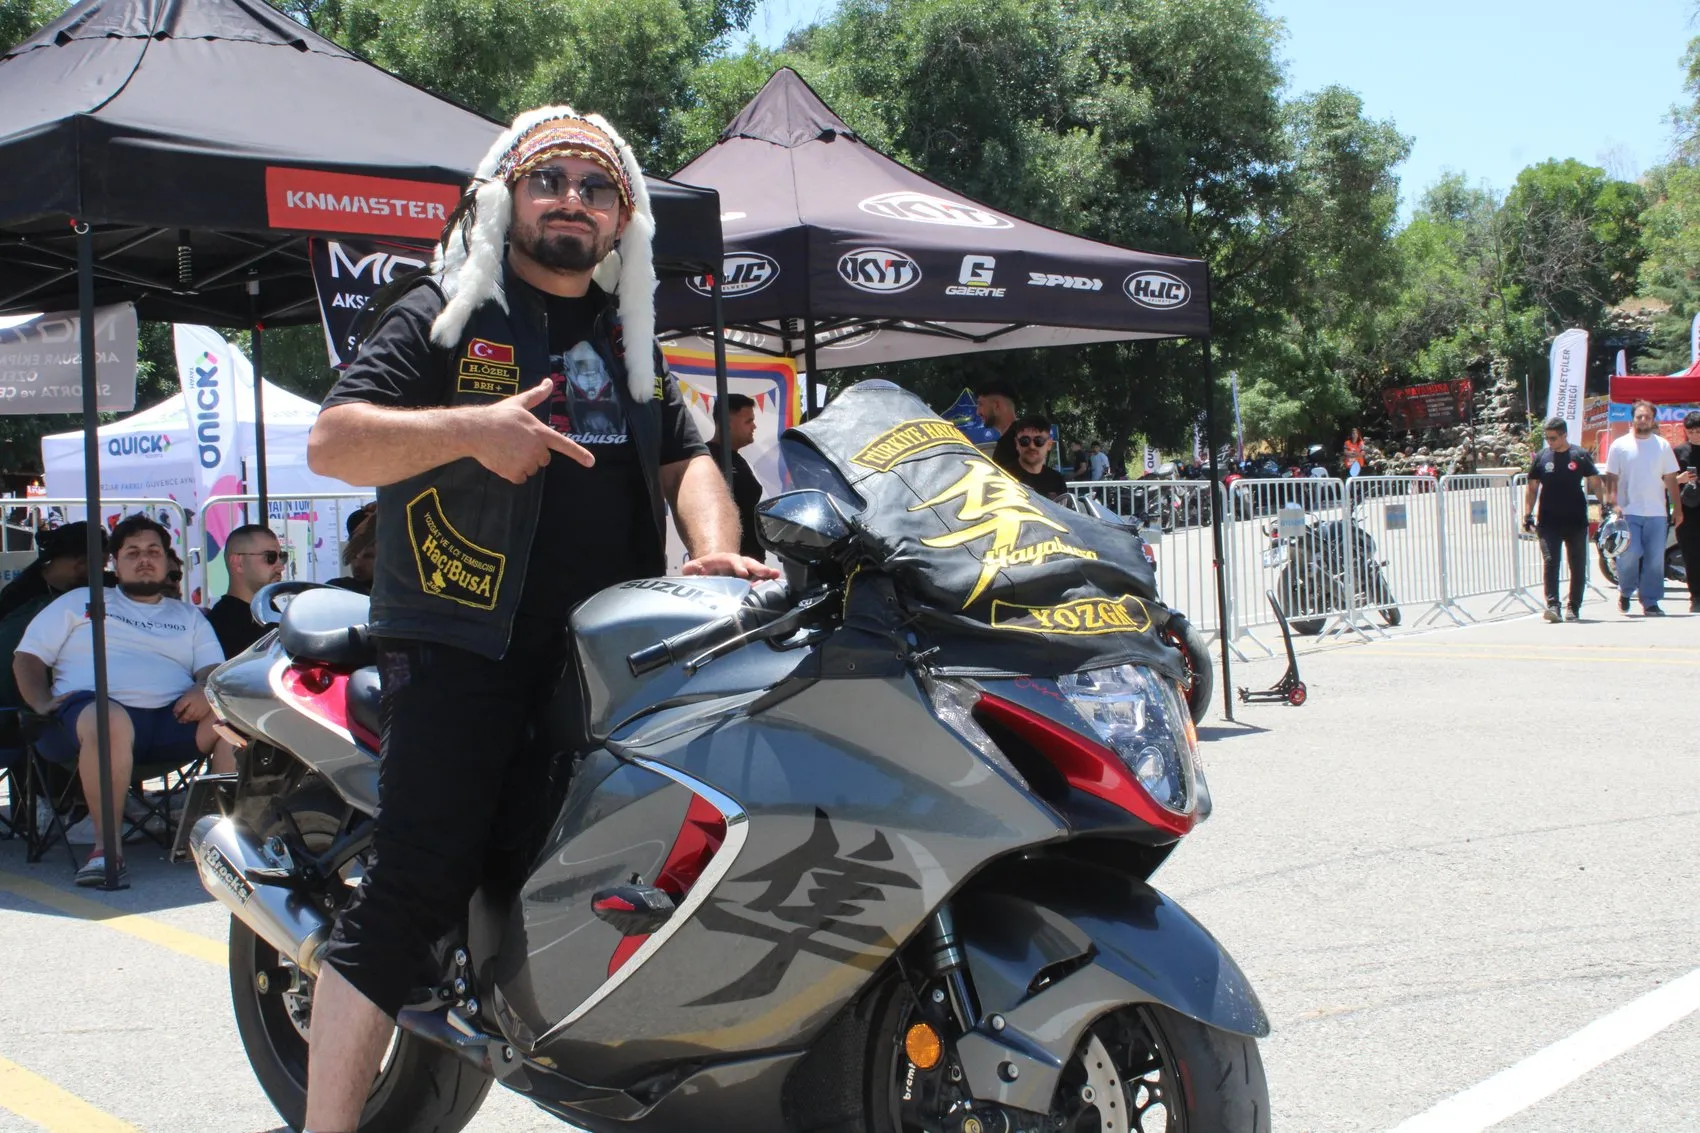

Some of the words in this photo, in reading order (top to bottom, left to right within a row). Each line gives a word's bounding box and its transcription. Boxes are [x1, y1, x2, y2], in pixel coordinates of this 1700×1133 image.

[286, 190, 446, 220] KNMASTER
[1027, 272, 1104, 291] SPIDI
[1134, 280, 1182, 300] HJC
[1556, 349, 1571, 421] OTOSİKLETÇİLER
[195, 366, 222, 469] QUICK
[107, 434, 163, 456] QUICK
[982, 536, 1099, 567] Hayabusa
[163, 623, 187, 631] 1903
[902, 1062, 917, 1100] brem
